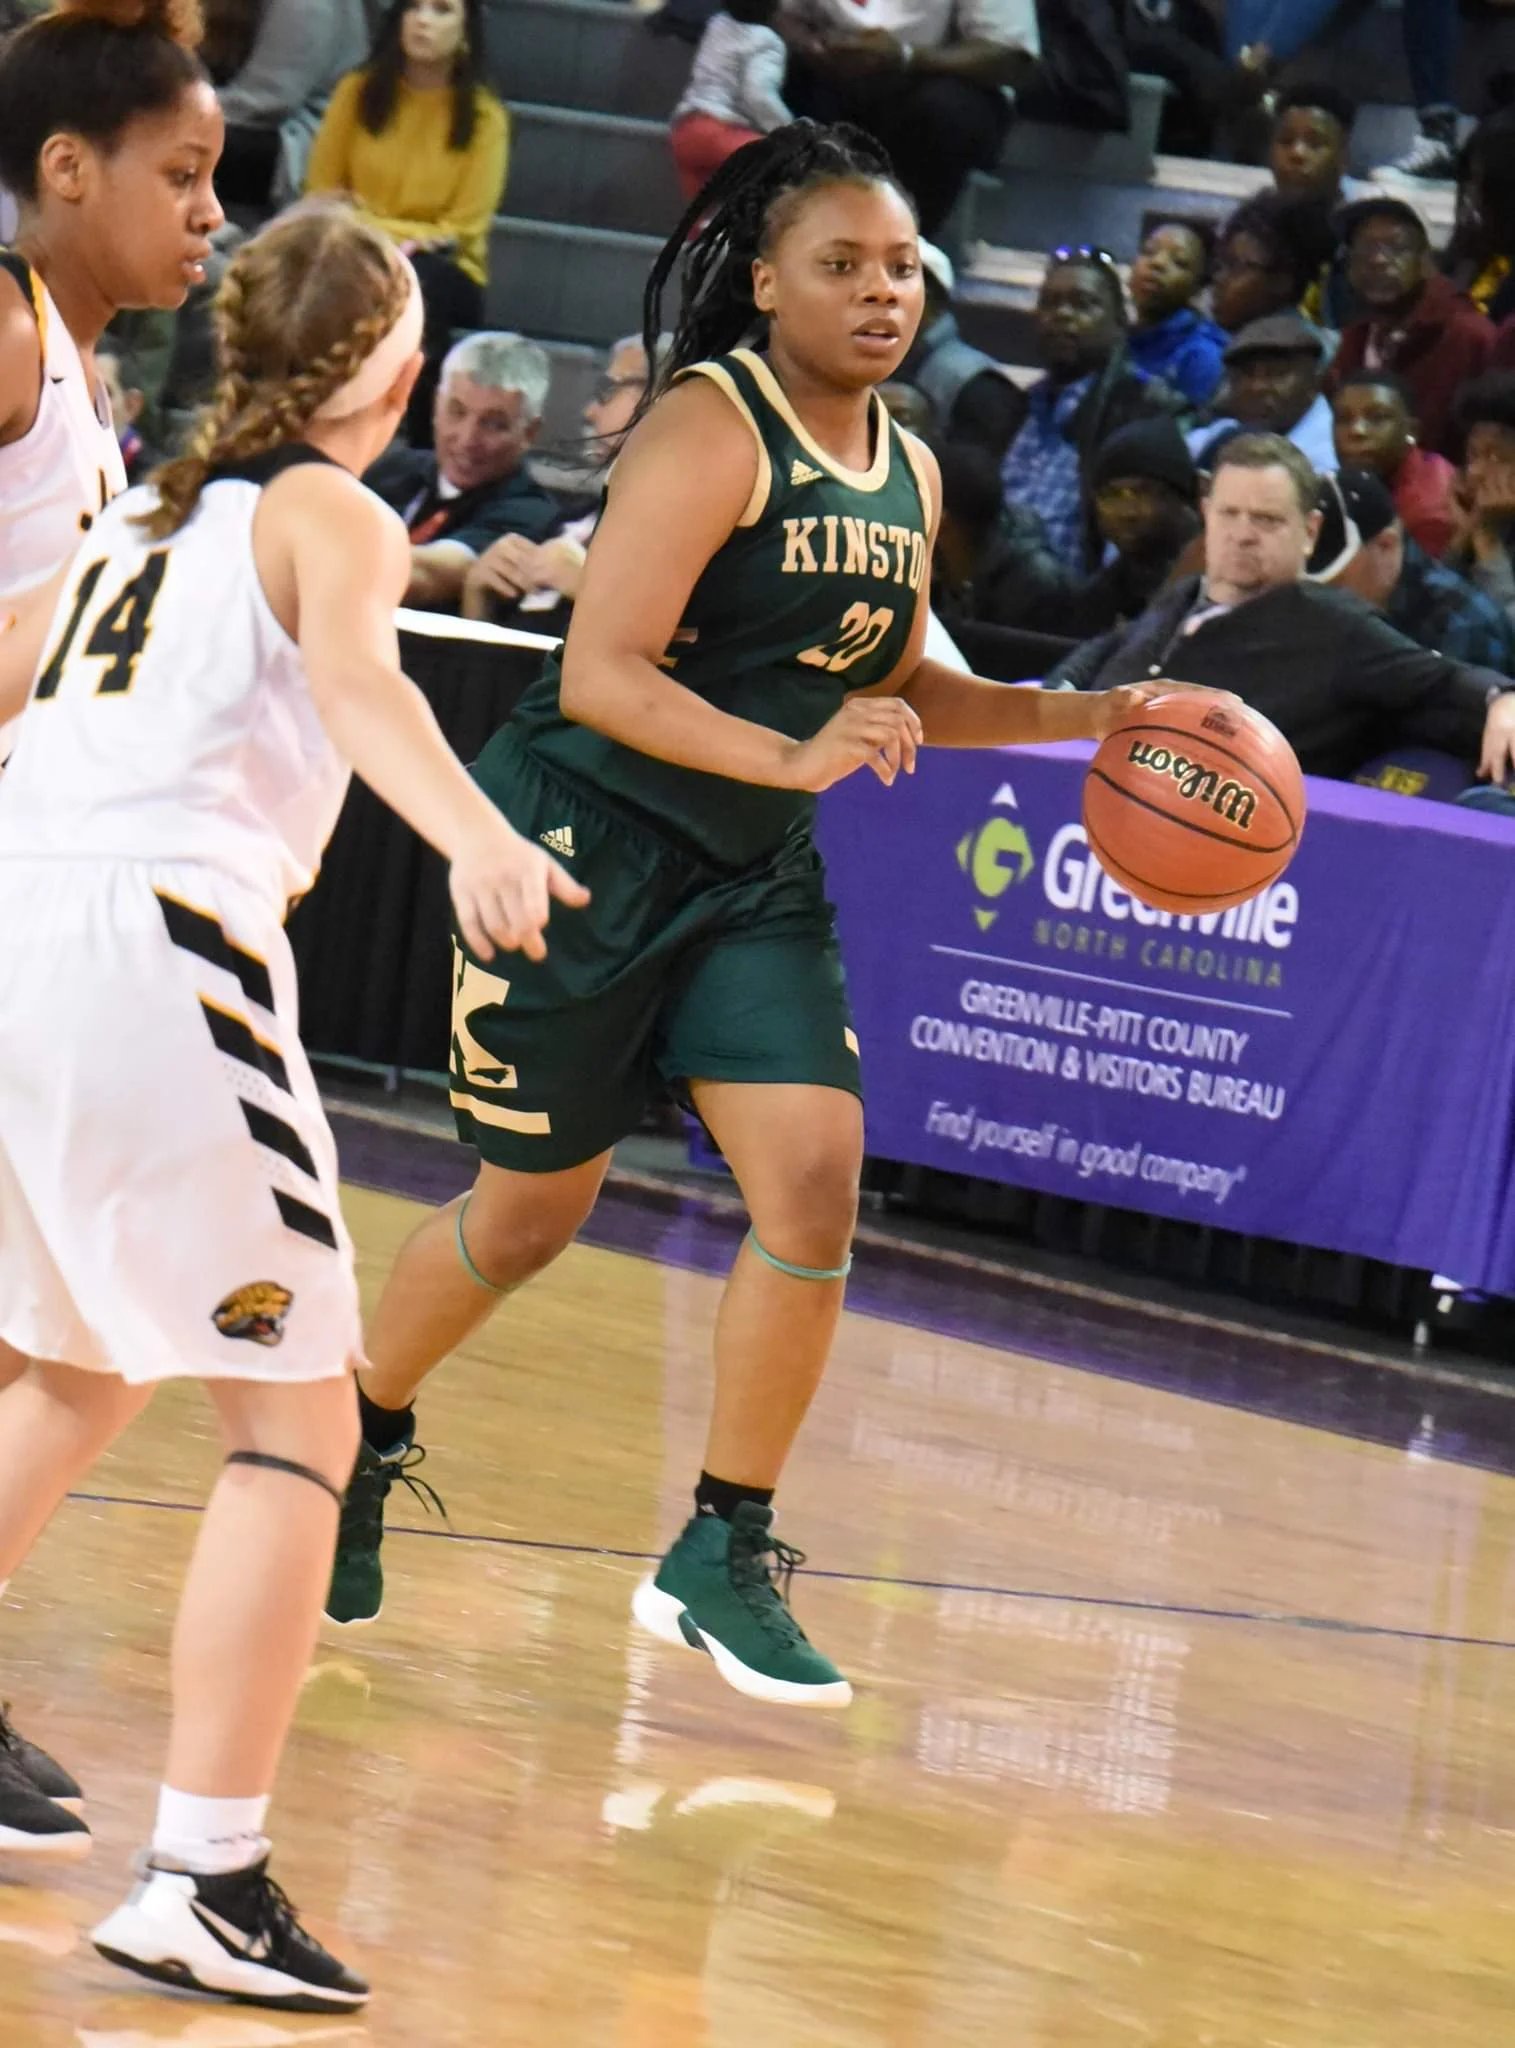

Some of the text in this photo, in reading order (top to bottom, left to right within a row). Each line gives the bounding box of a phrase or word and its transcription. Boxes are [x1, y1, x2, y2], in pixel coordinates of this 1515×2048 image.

[781, 515, 927, 593] KINSTO
[33, 549, 172, 701] 14
[796, 600, 894, 672] 20
[1128, 740, 1258, 829] Wilson
[1043, 823, 1299, 949] Grele
[1033, 918, 1282, 988] NORTH CAROLINA
[960, 979, 1249, 1065] GREENVILLE-PITT COUNTY
[910, 1014, 1285, 1120] CONVENTION & VISITORS BUREAU
[925, 1101, 976, 1141] Find
[969, 1118, 1059, 1159] yourself
[1056, 1127, 1078, 1164] in
[1078, 1141, 1141, 1179] good
